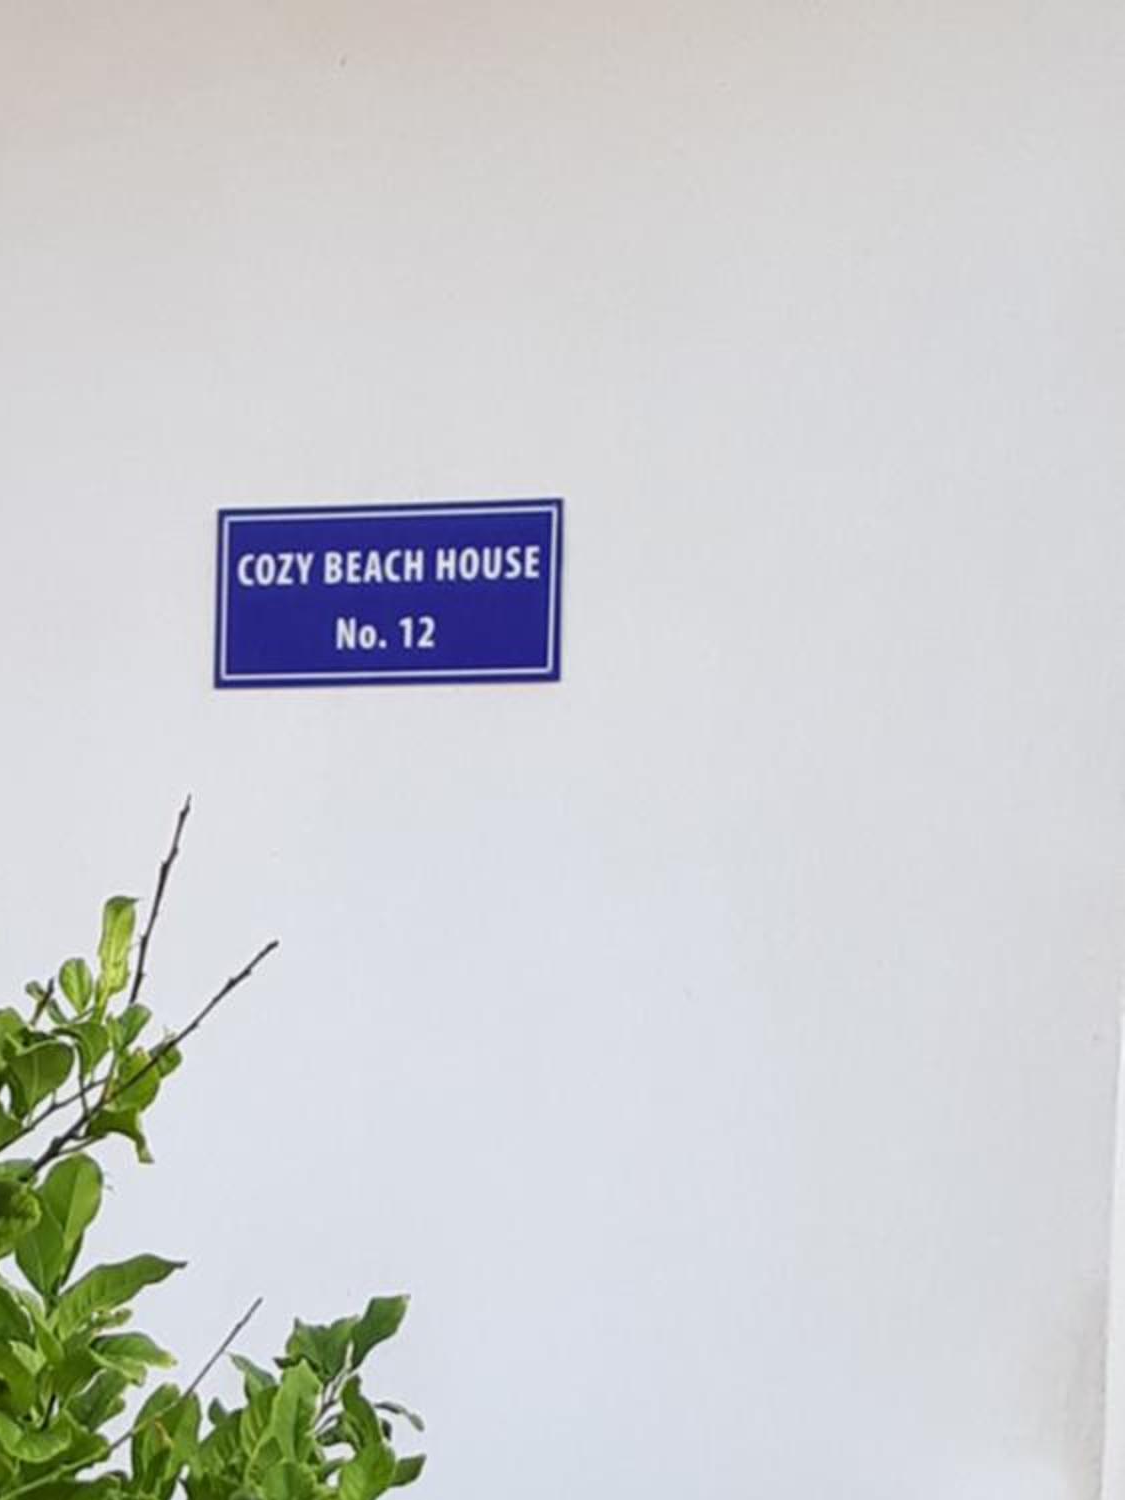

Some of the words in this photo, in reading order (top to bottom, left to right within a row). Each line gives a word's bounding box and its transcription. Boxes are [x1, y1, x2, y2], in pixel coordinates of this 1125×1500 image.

[237, 553, 314, 586] COZY
[324, 549, 425, 584] BEACH
[436, 545, 540, 580] HOUSE
[336, 618, 387, 649] No.
[400, 616, 435, 648] 12
